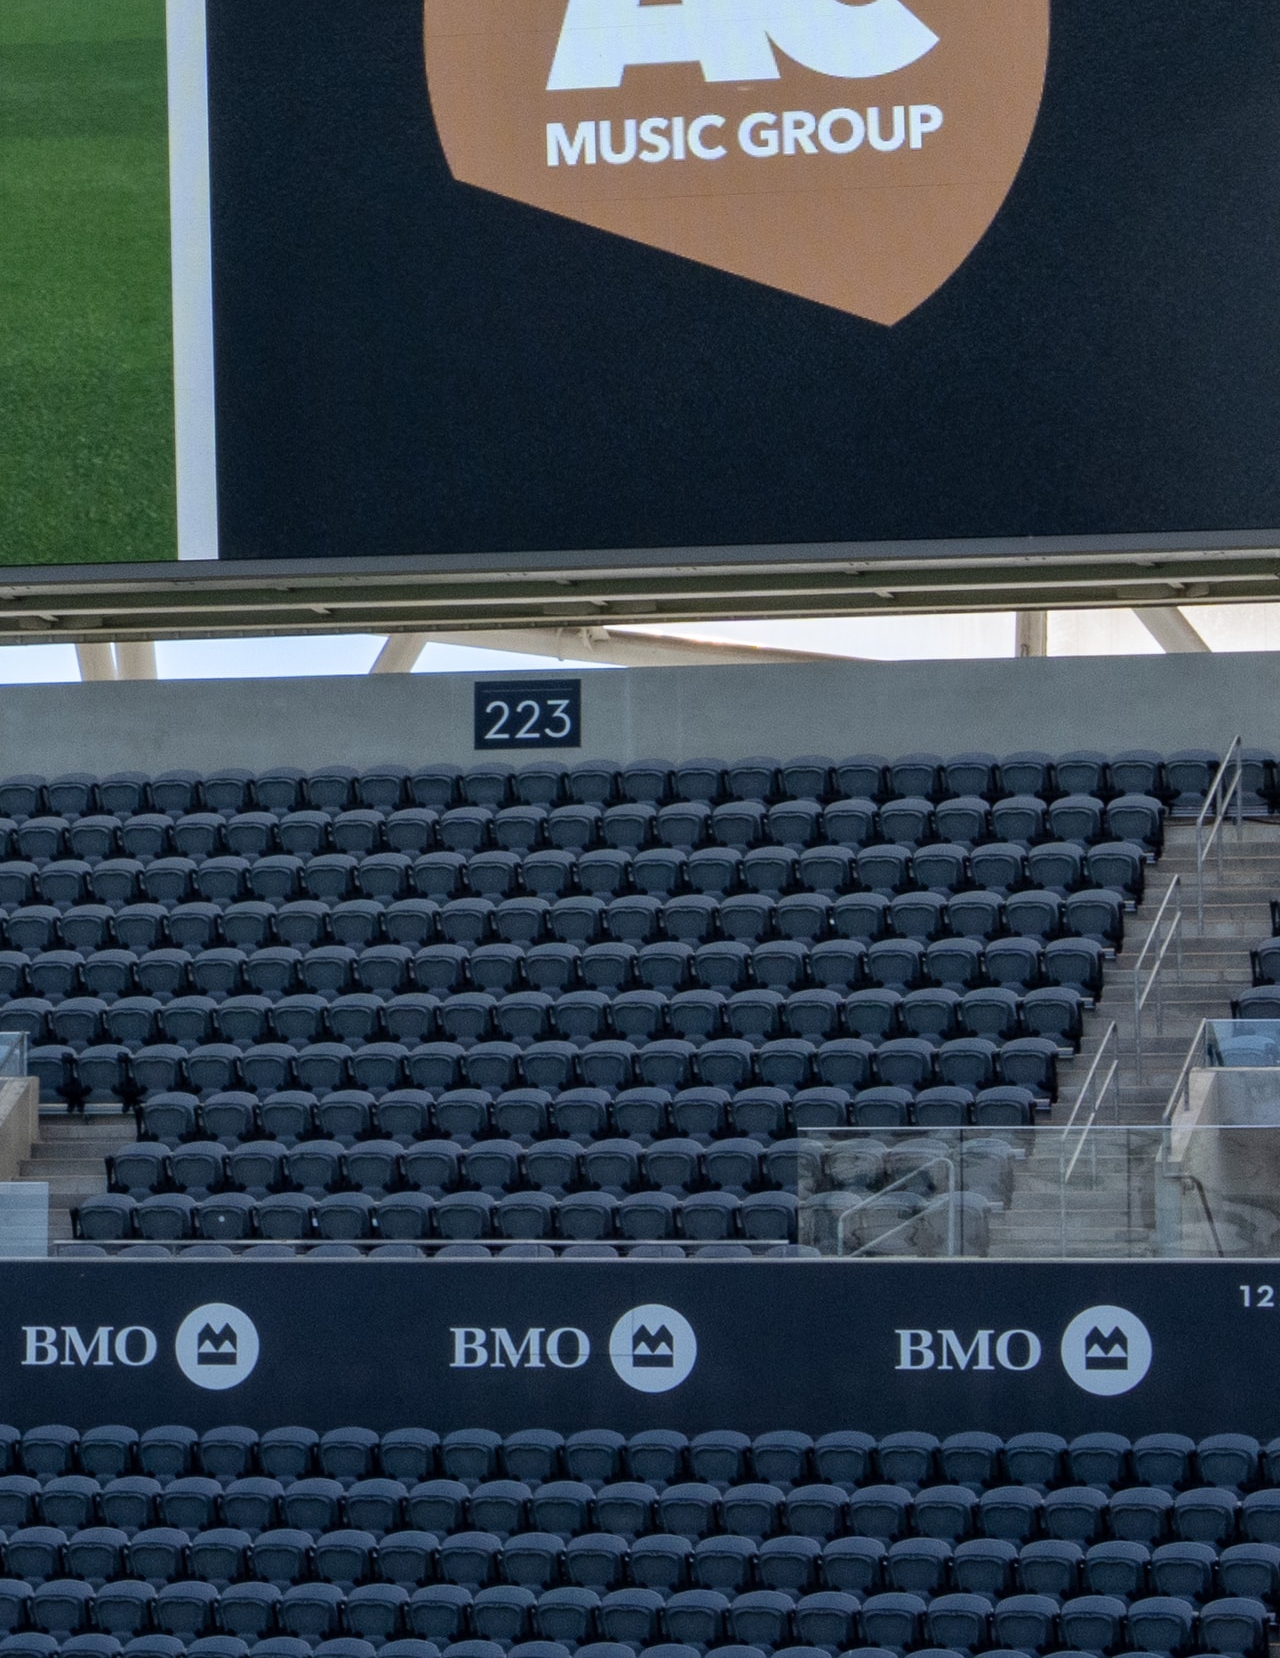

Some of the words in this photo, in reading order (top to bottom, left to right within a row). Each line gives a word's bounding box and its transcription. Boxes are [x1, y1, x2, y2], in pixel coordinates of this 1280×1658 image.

[547, 115, 726, 166] MUSIC
[738, 105, 942, 157] GROUP
[485, 700, 570, 738] 223
[1240, 1285, 1280, 1308] 12
[21, 1326, 157, 1366] BMO
[450, 1328, 590, 1368] BMO
[895, 1330, 1041, 1370] BMO
